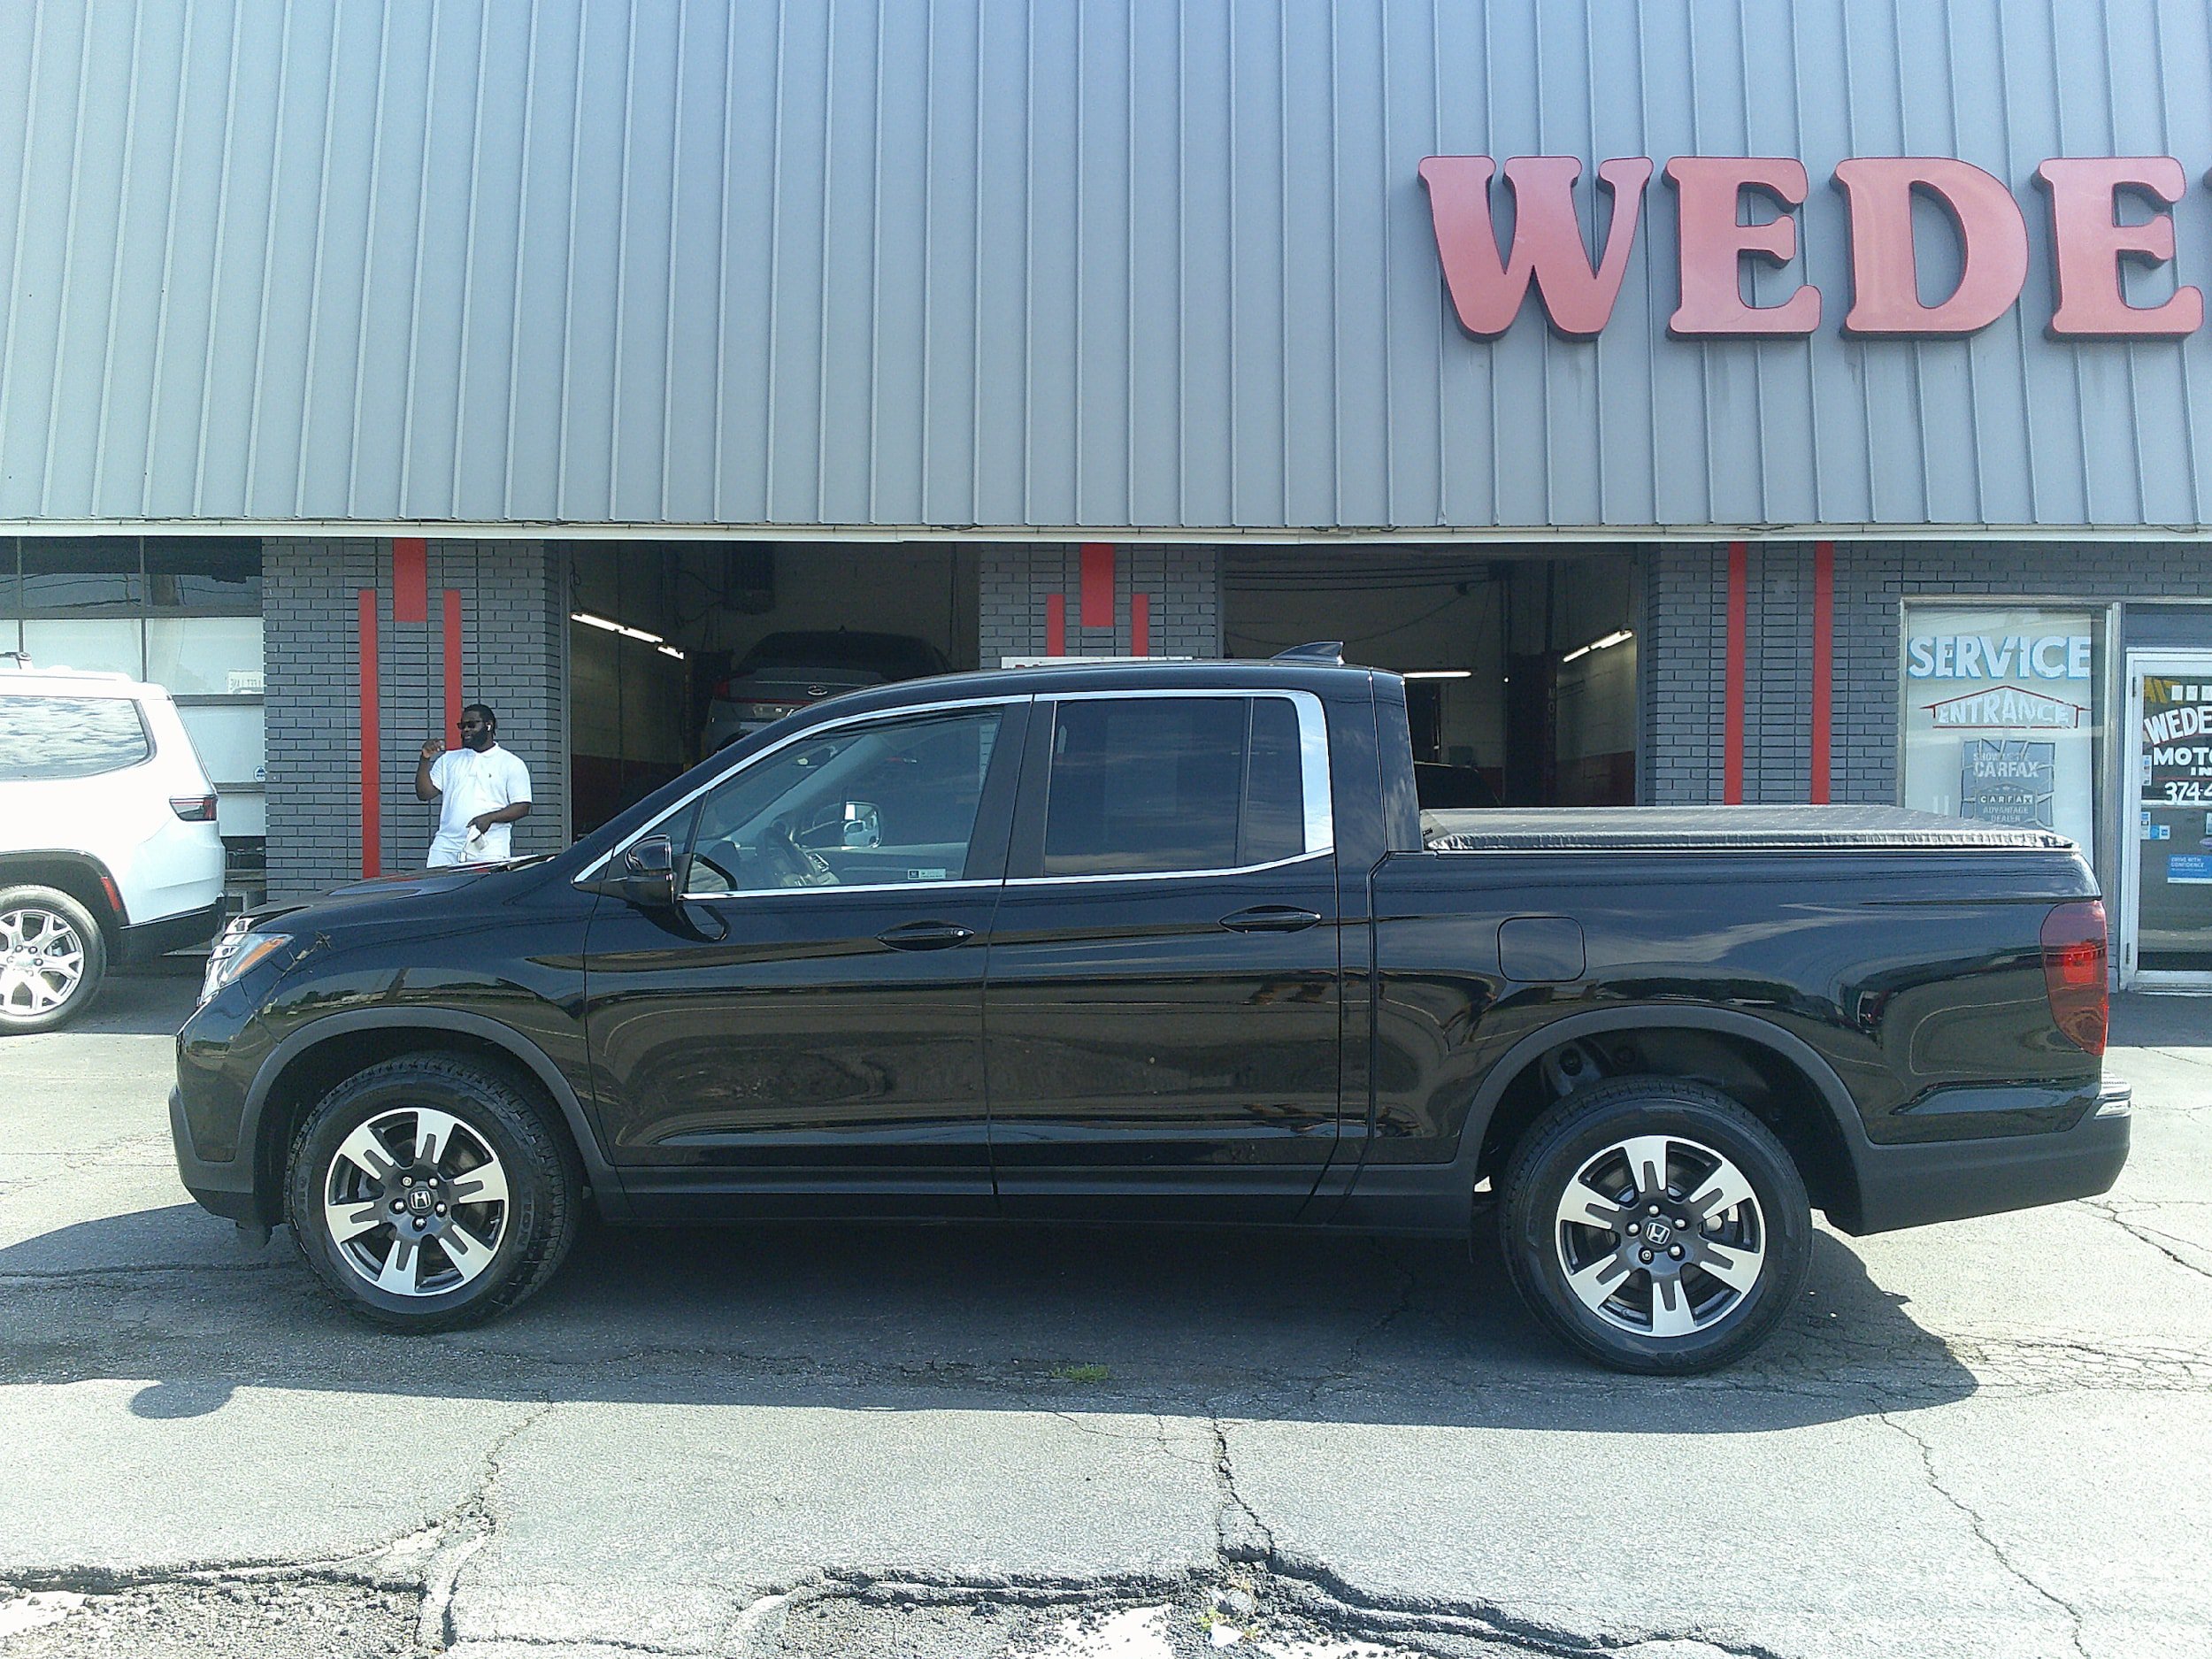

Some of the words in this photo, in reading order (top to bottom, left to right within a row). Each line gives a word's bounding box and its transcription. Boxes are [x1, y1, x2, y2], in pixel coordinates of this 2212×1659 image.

[1909, 636, 2092, 679] SERVICE
[1938, 690, 2070, 724] ENTRANCE
[2144, 705, 2212, 744] WEDE
[1973, 761, 2039, 778] CARFAX
[2154, 747, 2212, 765] MOT
